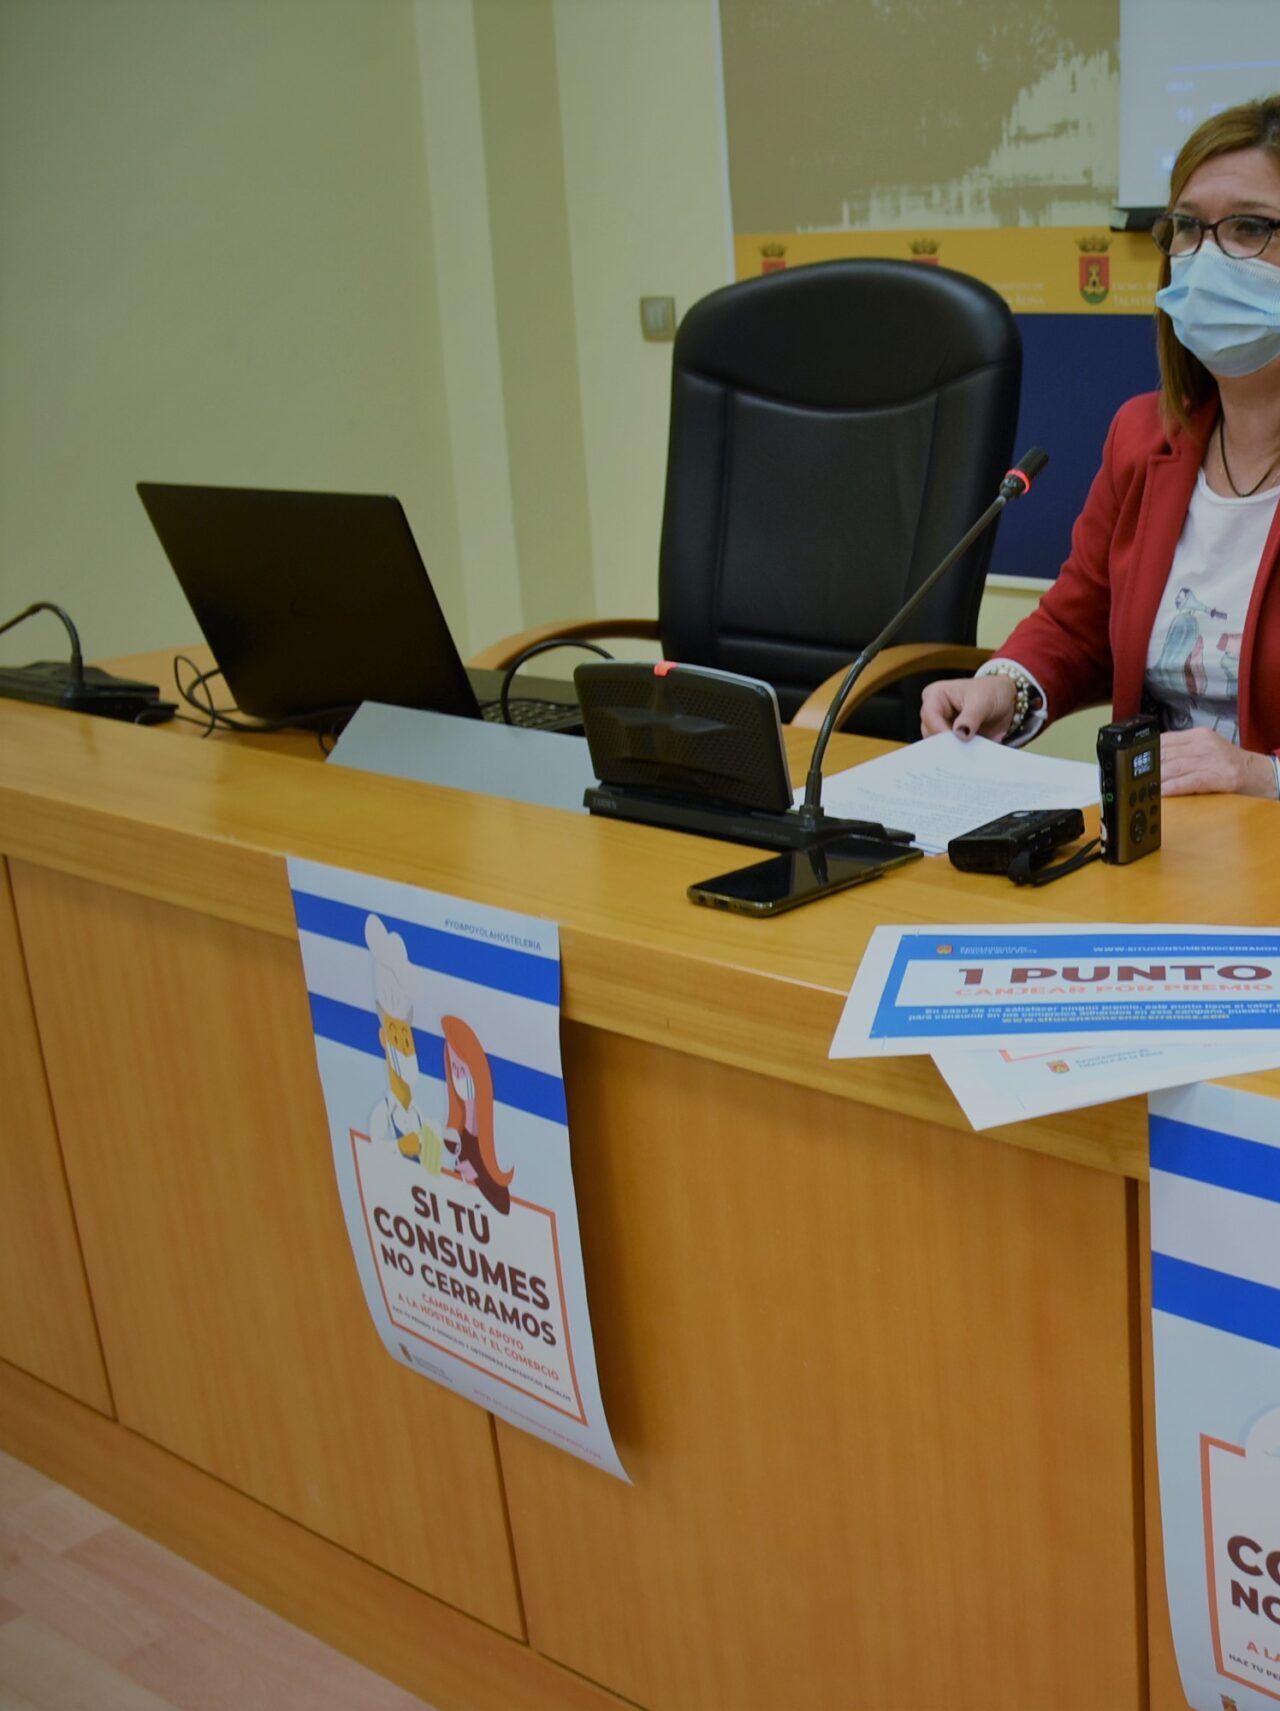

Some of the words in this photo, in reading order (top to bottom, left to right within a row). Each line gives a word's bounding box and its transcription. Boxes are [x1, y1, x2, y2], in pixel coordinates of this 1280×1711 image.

[444, 918, 542, 951] #YOAPOYOLAHOSTELERIA
[955, 985, 1086, 996] CANJEAR
[1095, 984, 1155, 993] POR
[1164, 983, 1274, 992] PREMIO
[958, 967, 984, 985] 1
[1009, 964, 1273, 984] PUNTO
[411, 1185, 440, 1224] SI
[447, 1199, 490, 1245] TÚ
[373, 1206, 550, 1311] CONSUMES
[380, 1243, 414, 1278] NO
[420, 1264, 557, 1346] CERRAMOS
[472, 1317, 486, 1331] DE
[489, 1326, 525, 1351] APOYO
[503, 1347, 560, 1382] COMERCIO
[1246, 1640, 1259, 1655] A
